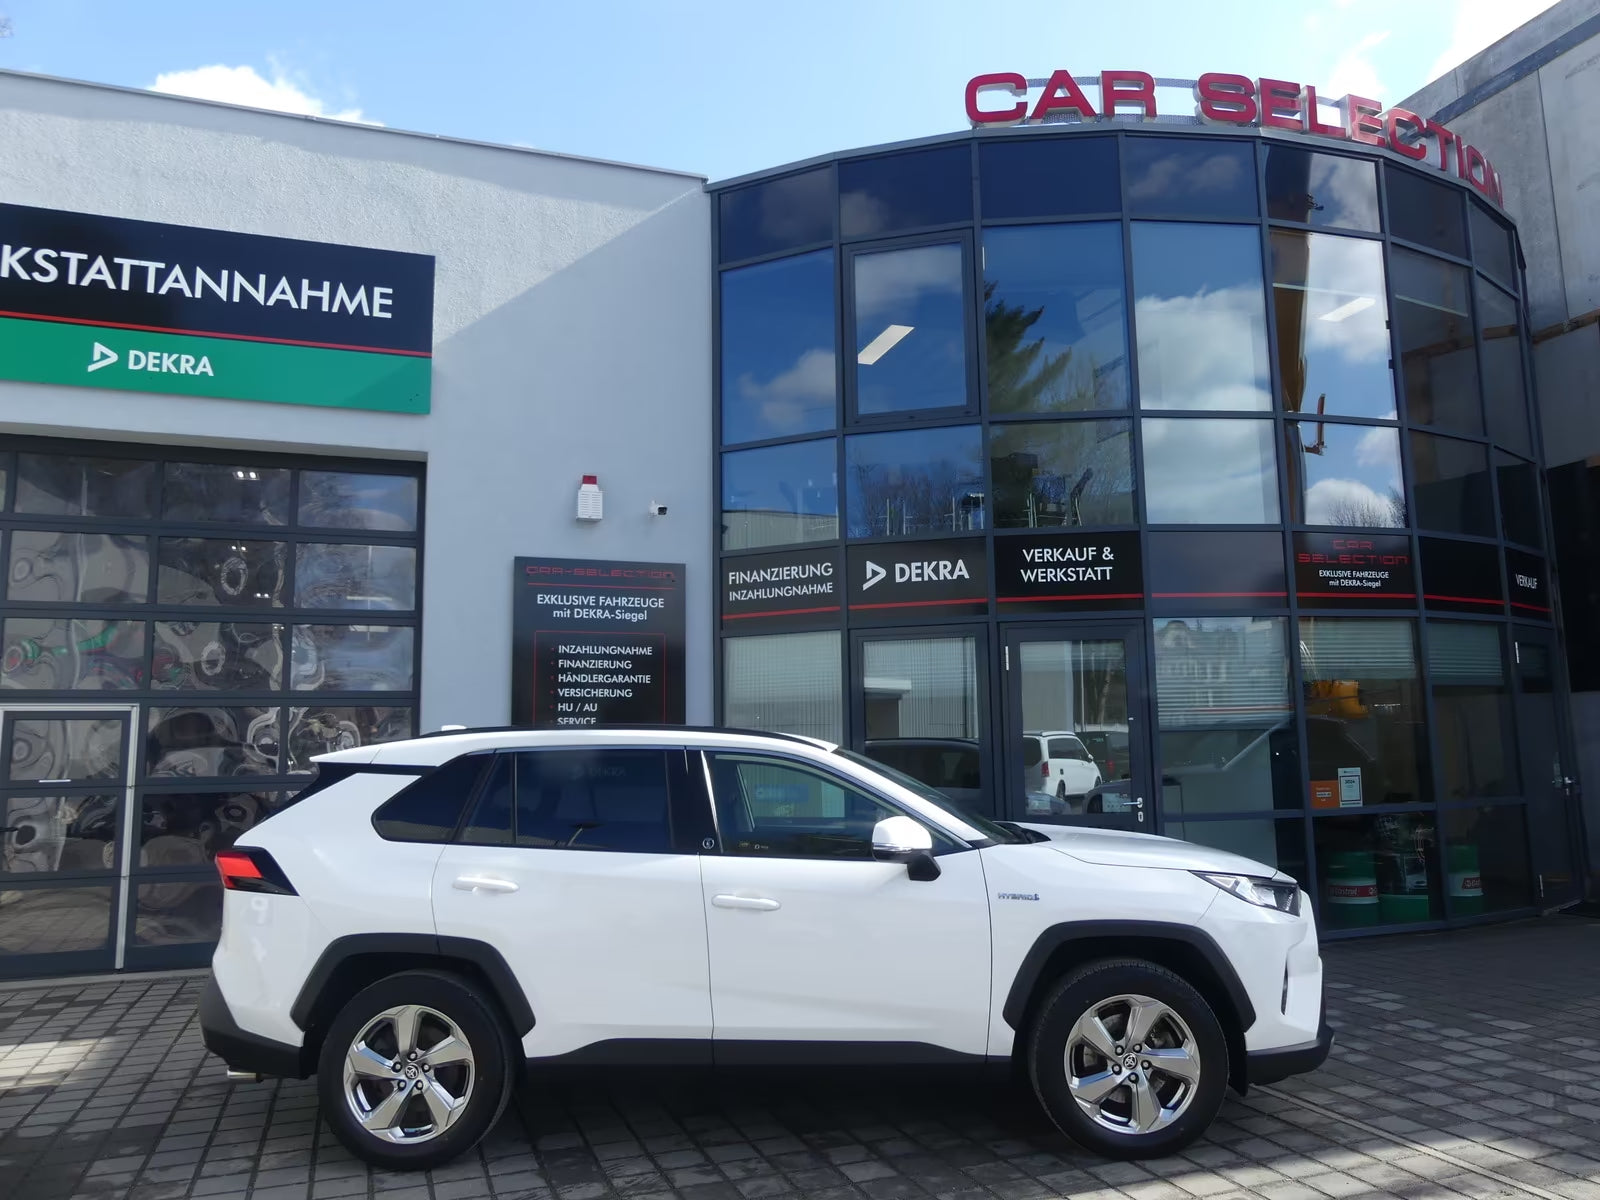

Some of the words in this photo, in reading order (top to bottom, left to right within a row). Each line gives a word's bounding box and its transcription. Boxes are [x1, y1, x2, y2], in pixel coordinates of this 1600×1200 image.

[964, 69, 1158, 126] CAR
[1195, 72, 1504, 210] SELECTION
[0, 244, 393, 319] KSTATTANNAHME
[128, 349, 214, 377] DEKRA
[1022, 547, 1097, 564] VERKAUF
[1102, 546, 1114, 561] &
[728, 562, 833, 585] FINANZIERUNG
[895, 559, 969, 583] DEKRA
[1020, 566, 1113, 583] WERKSTATT
[1318, 569, 1352, 579] EXKLUSIVE
[1353, 570, 1390, 579] FAHRZEUGE
[1329, 579, 1339, 587] mit
[1340, 579, 1381, 588] DEKRA-Siegel
[1515, 573, 1538, 589] VERKAUF
[729, 582, 833, 602] INZAHLUNGNAHME
[537, 594, 596, 606] EXKLUSIVE
[599, 596, 665, 608] FAHRZEUGE
[553, 608, 571, 618] mit
[574, 608, 648, 622] DEKRA-Siegel
[558, 645, 653, 655] INZAHLUNGNAHME
[558, 660, 632, 669] FINANZIERUNG
[558, 672, 651, 684] HÄNDLERGARANTIE
[558, 688, 633, 698] VERSICHERUNG
[558, 703, 574, 712] HU
[575, 703, 581, 712] /
[583, 703, 598, 712] AU
[557, 717, 597, 725] SERVICE
